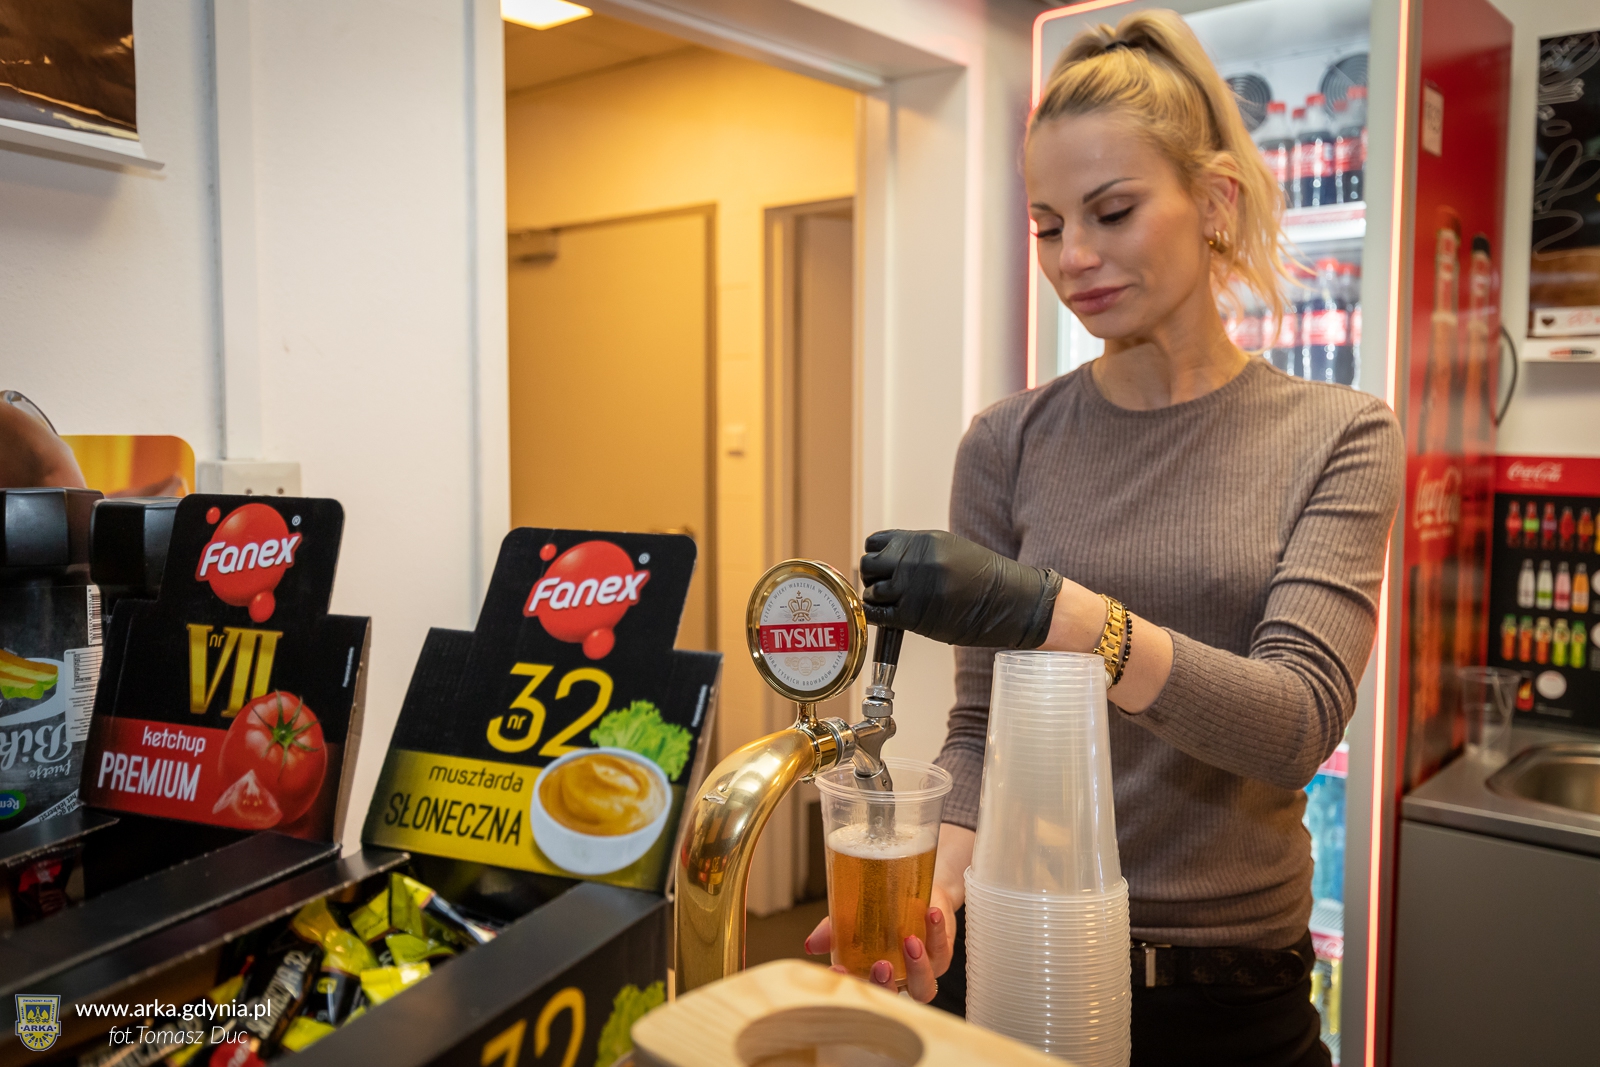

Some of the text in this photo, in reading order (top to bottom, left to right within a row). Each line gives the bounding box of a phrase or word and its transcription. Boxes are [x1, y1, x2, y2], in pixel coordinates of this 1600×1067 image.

[199, 534, 300, 577] Fanex
[528, 571, 646, 612] Fanex
[209, 633, 225, 648] nr
[769, 627, 836, 649] TYSKIE
[486, 661, 614, 758] nr 32
[142, 725, 207, 757] ketchup
[97, 751, 202, 802] PREMIUM
[428, 764, 524, 793] musztarda
[384, 791, 523, 847] SŁONECZNA
